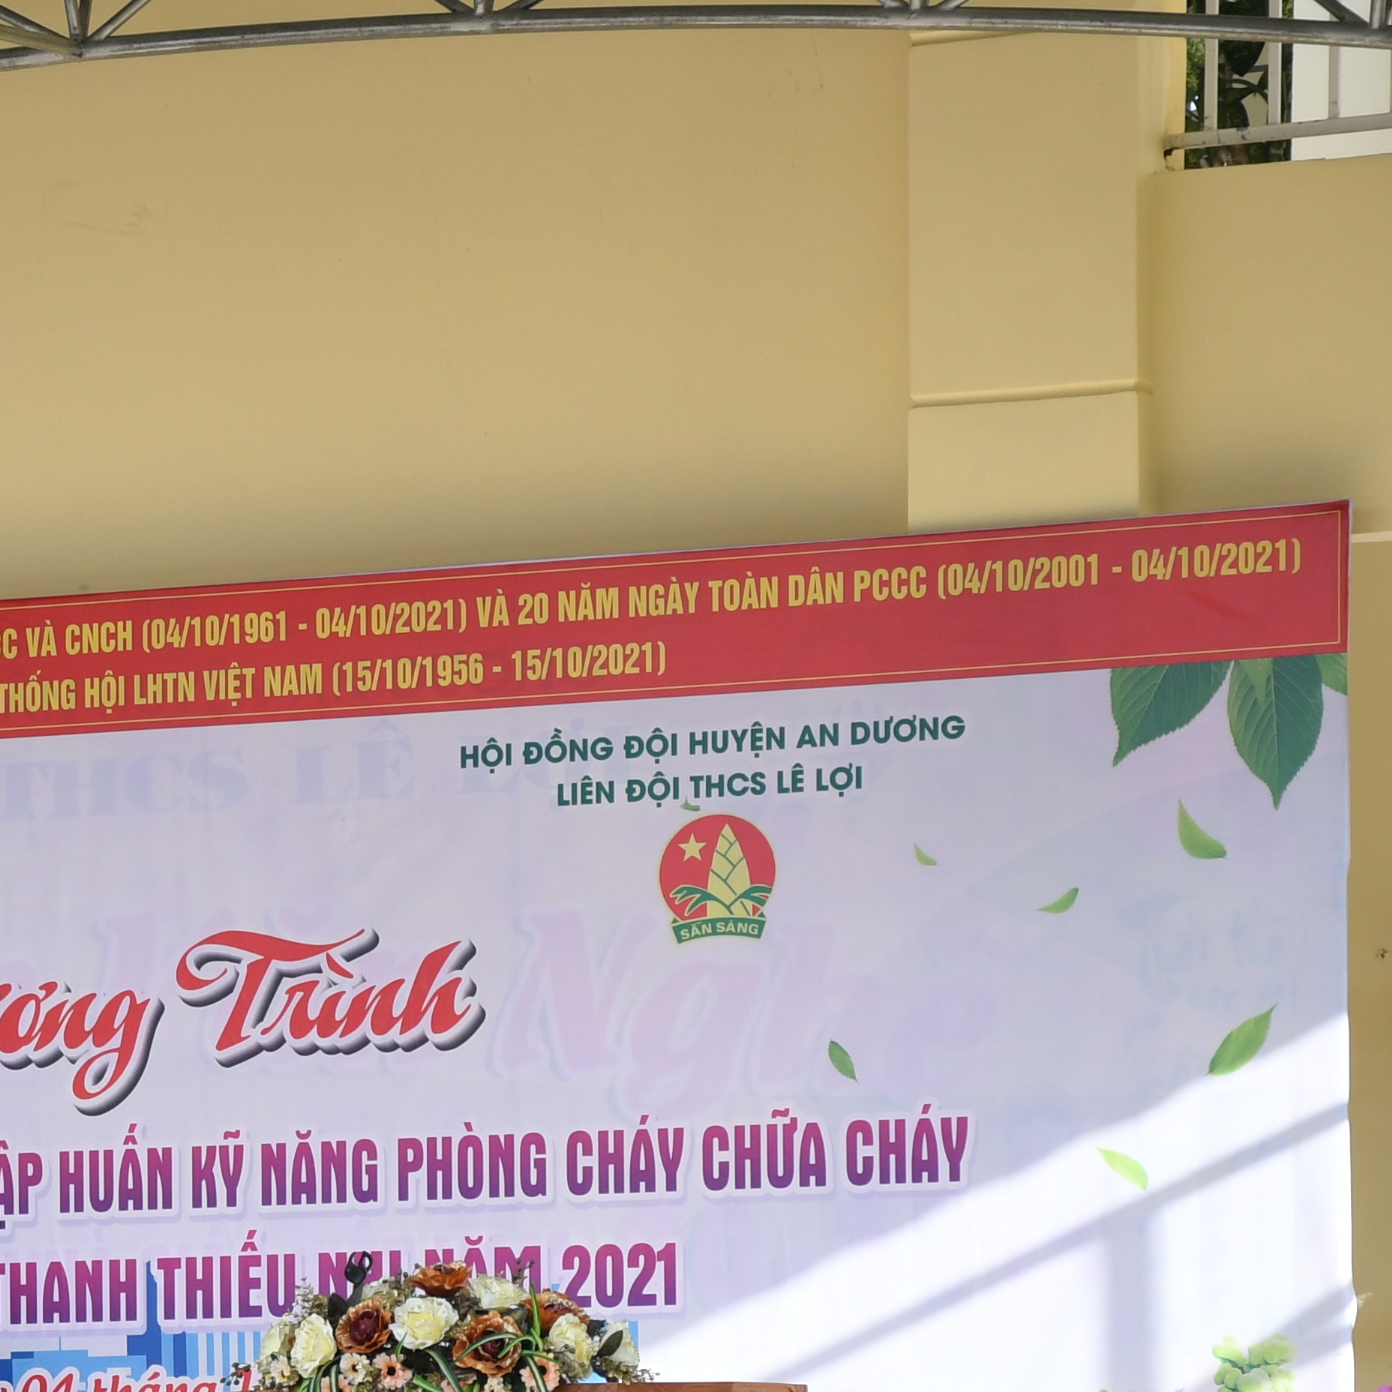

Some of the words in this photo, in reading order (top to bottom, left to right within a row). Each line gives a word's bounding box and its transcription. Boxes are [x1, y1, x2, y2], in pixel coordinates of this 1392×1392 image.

[25, 619, 58, 658] VÀ
[65, 620, 133, 656] CNCH
[142, 610, 287, 653] (04/10/1961
[315, 598, 467, 639] 04/10/2021)
[476, 588, 510, 628] VÀ
[517, 592, 549, 626] 20
[557, 582, 620, 623] NĂM
[628, 576, 700, 618] NGÀY
[708, 571, 779, 612] TOÀN
[788, 566, 845, 607] DÂN
[853, 565, 927, 603] PCCC
[937, 553, 1099, 600] (04/10/2001
[1131, 538, 1301, 583] 04/10/2021)
[84, 669, 126, 714] HỘI
[133, 671, 196, 705] LHTN
[203, 661, 256, 707] VIỆT
[263, 662, 323, 698] NAM
[332, 652, 484, 696] (15/10/1956
[511, 641, 666, 681] 15/10/2021)
[461, 738, 512, 774] HỘI
[523, 728, 614, 765] ĐỒNG
[624, 727, 679, 764] ĐỘI
[691, 721, 786, 758] HUYỆN
[797, 724, 840, 748] AN
[851, 715, 965, 746] DƯƠNG
[558, 775, 615, 807] LIÊN
[625, 771, 680, 807] ĐỘI
[691, 772, 767, 798] THCS
[778, 763, 805, 794] LÊ
[817, 764, 863, 797] LỢI
[716, 919, 760, 935] SÀNG
[177, 931, 466, 1050] Trình
[61, 1124, 171, 1212] HUẤN
[193, 1131, 243, 1207] KỸ
[262, 1132, 377, 1204] NĂNG
[399, 1123, 545, 1200] PHÒNG
[568, 1116, 683, 1194] CHÁY
[704, 1110, 825, 1189] CHỮA
[848, 1105, 967, 1185] CHÁY
[158, 1230, 294, 1319] THIẾU
[564, 1244, 675, 1306] 2021
